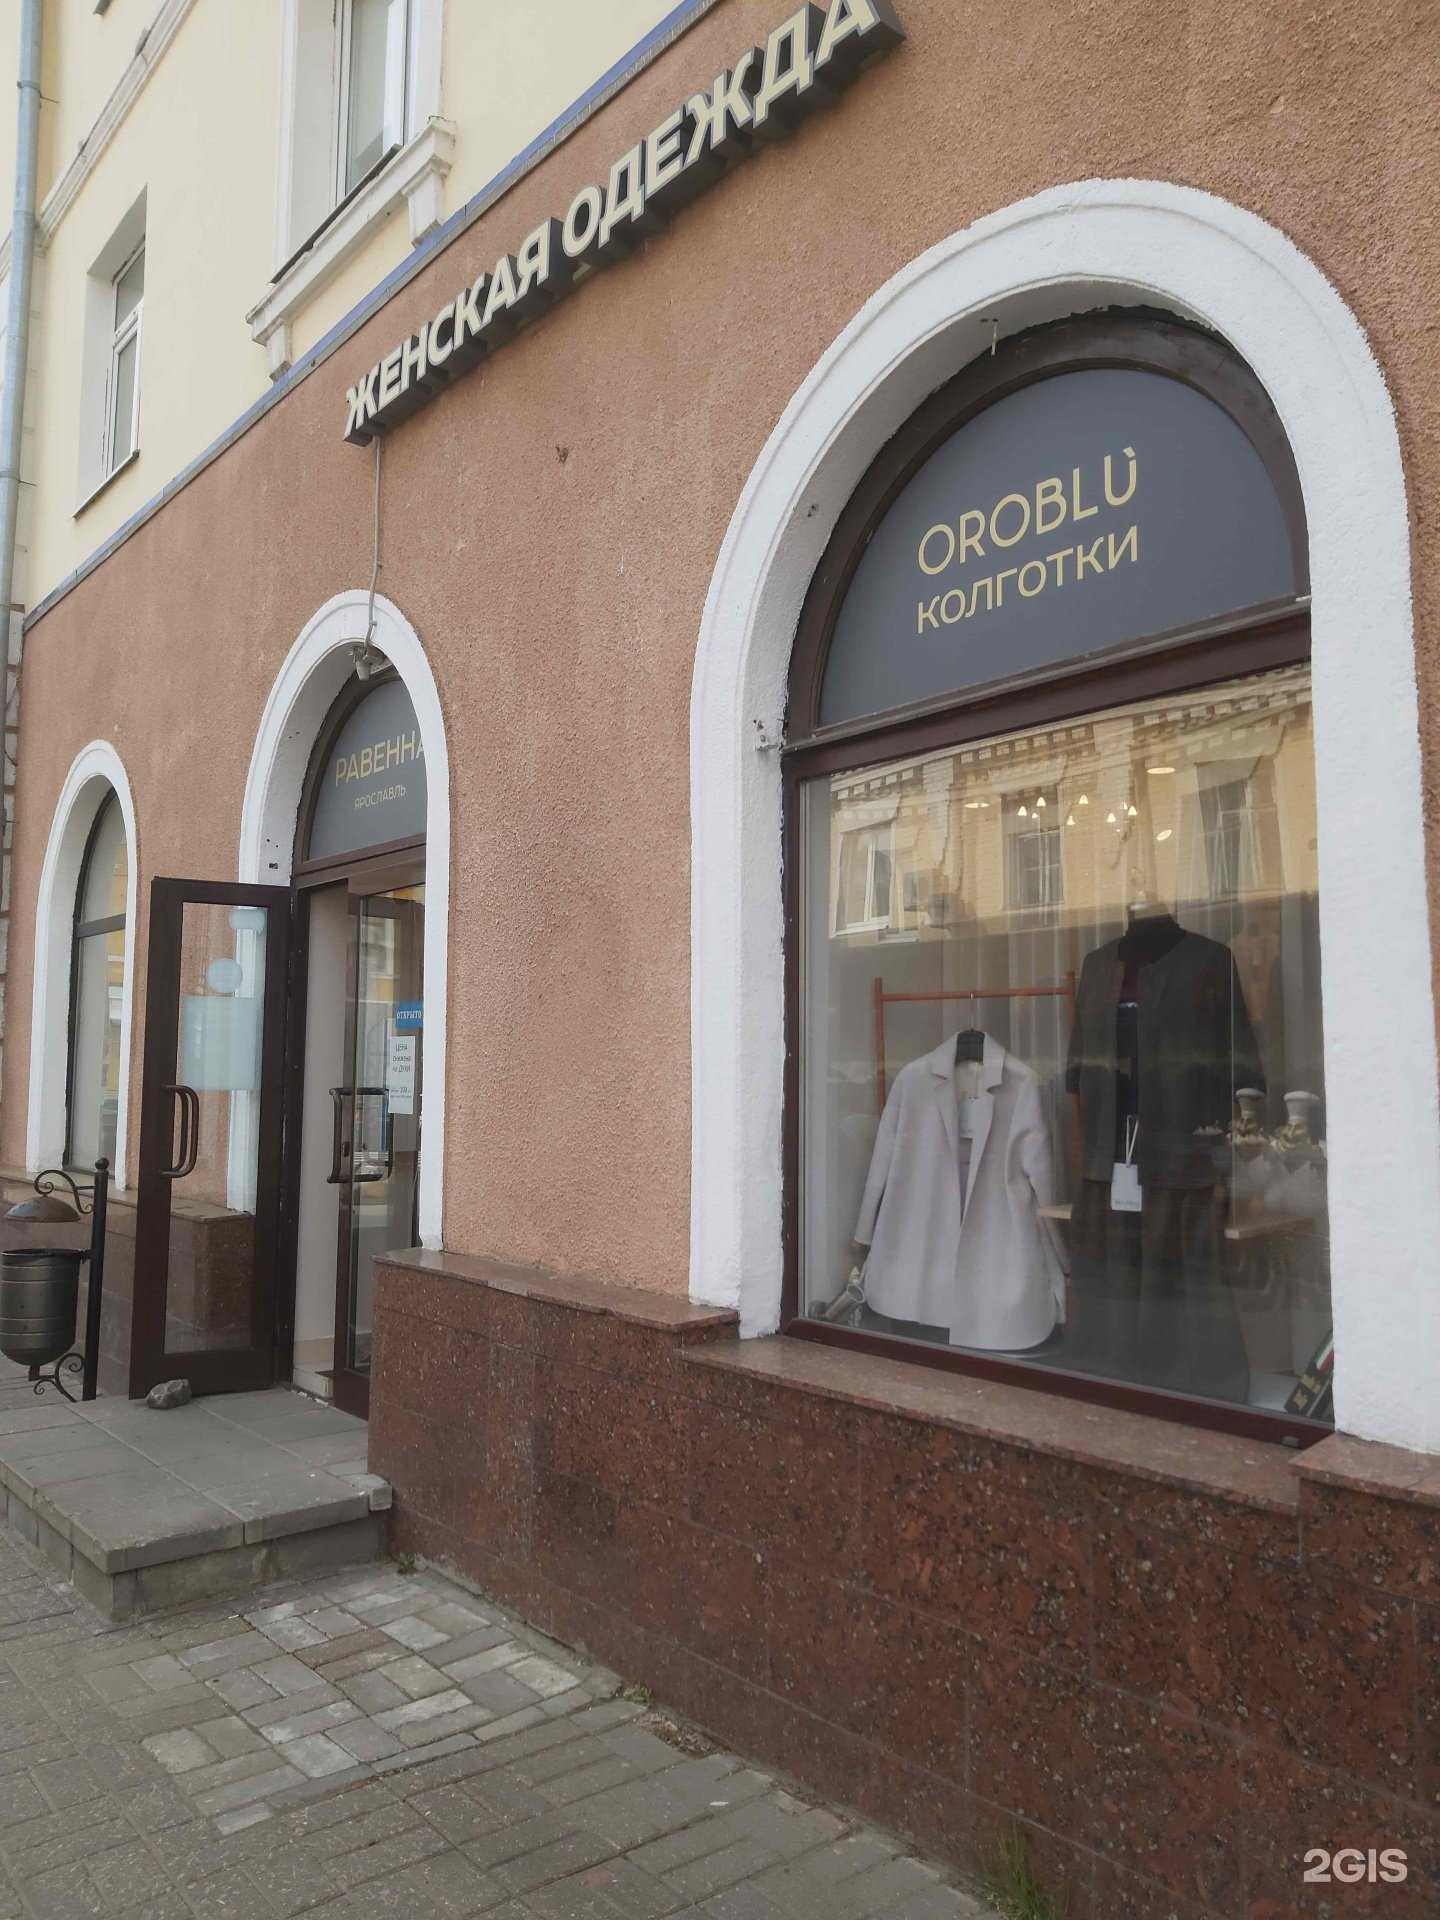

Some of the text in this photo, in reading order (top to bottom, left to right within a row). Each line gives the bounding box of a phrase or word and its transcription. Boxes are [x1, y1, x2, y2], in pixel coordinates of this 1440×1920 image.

[344, 0, 881, 440] ЖЕНСКАЯ ОДЕЖДА
[917, 525, 1138, 634] КОЛГОТКИ
